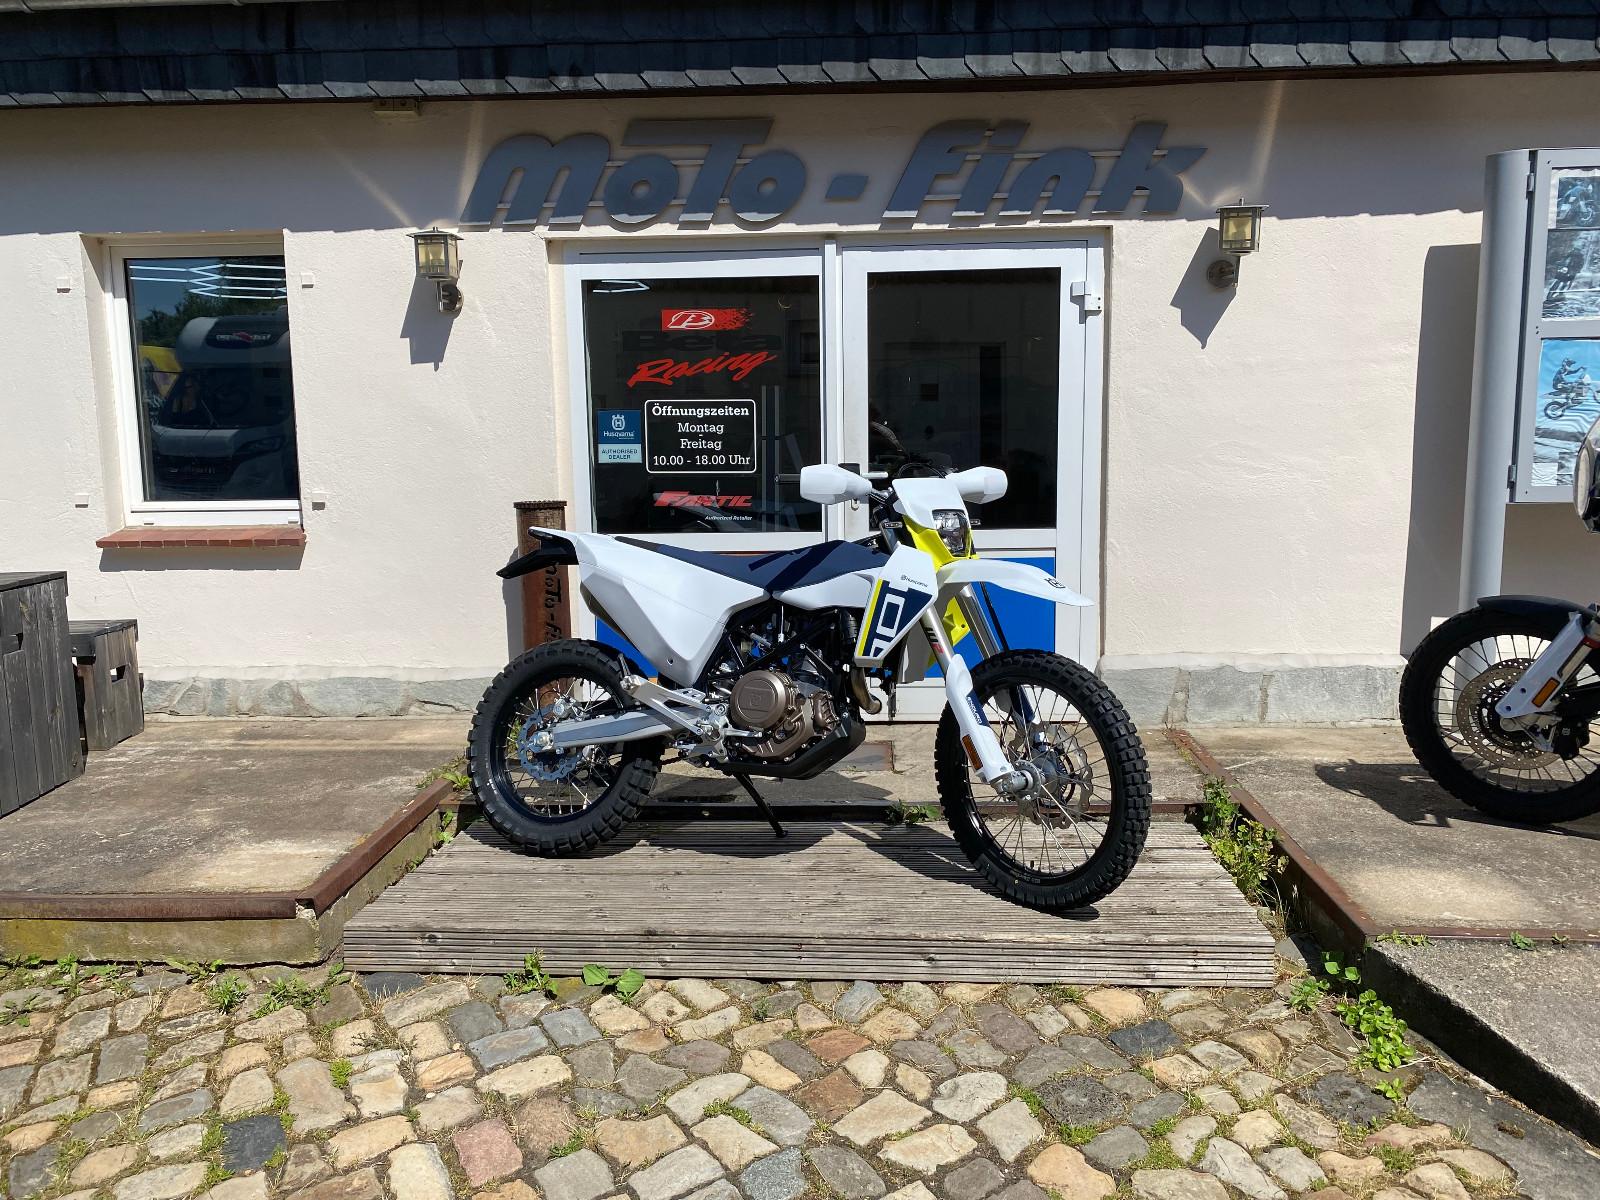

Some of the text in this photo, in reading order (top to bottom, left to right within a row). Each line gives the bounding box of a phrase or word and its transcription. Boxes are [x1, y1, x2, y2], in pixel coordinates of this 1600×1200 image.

[883, 118, 1208, 220] Fink
[627, 352, 778, 388] Racing
[652, 403, 750, 418] Öffnungszeiten
[603, 430, 635, 438] Husqvarna
[677, 422, 724, 434] Montag
[680, 438, 722, 451] Freitag
[653, 455, 684, 466] 10.00
[695, 455, 726, 465] 18.00
[729, 454, 751, 465] Uhr
